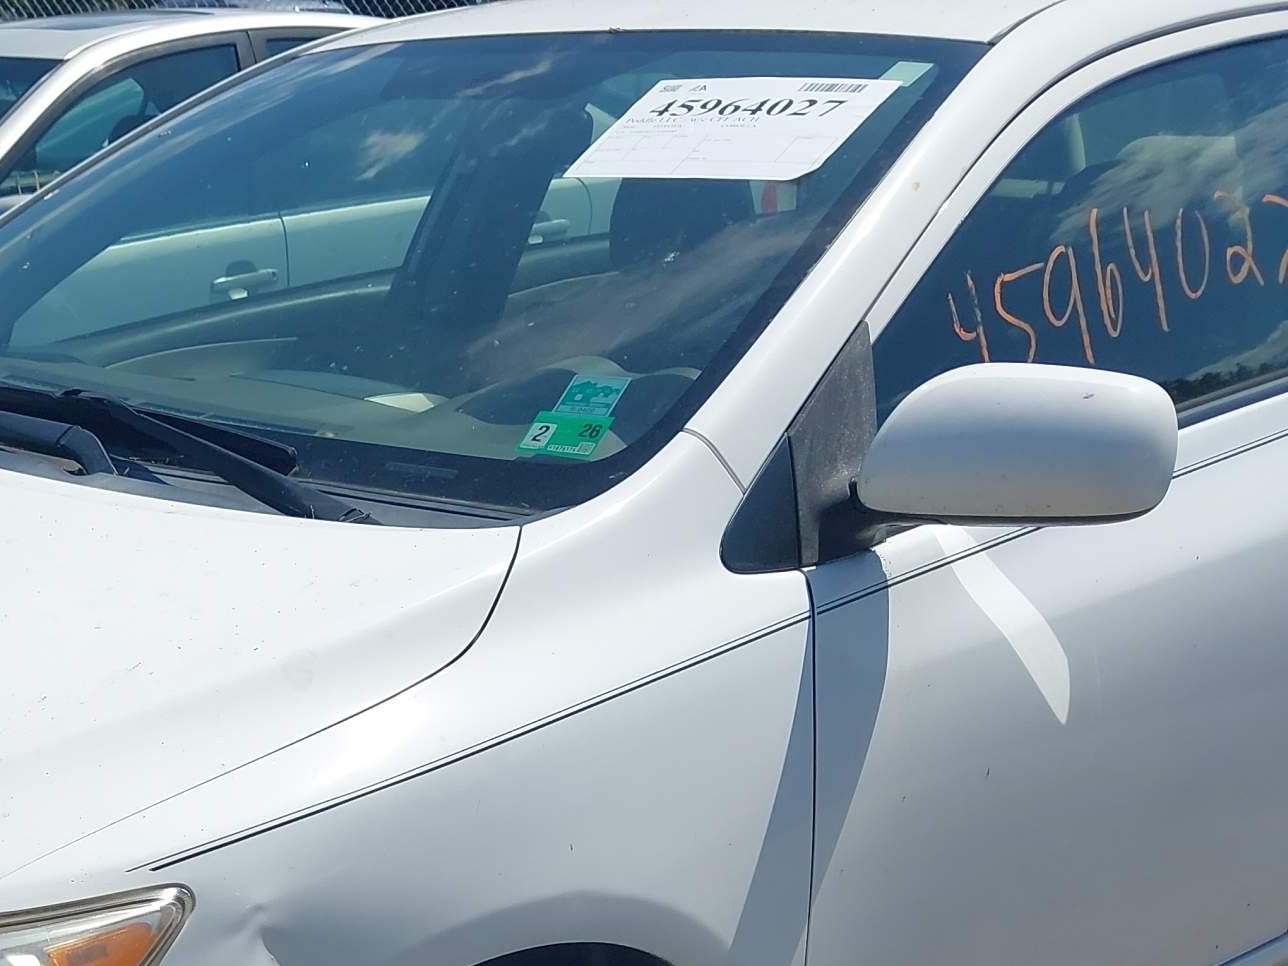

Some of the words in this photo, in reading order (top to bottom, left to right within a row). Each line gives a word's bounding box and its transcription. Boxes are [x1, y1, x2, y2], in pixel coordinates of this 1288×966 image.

[649, 98, 848, 117] 45964027
[531, 425, 550, 442] 2
[578, 423, 602, 439] 26
